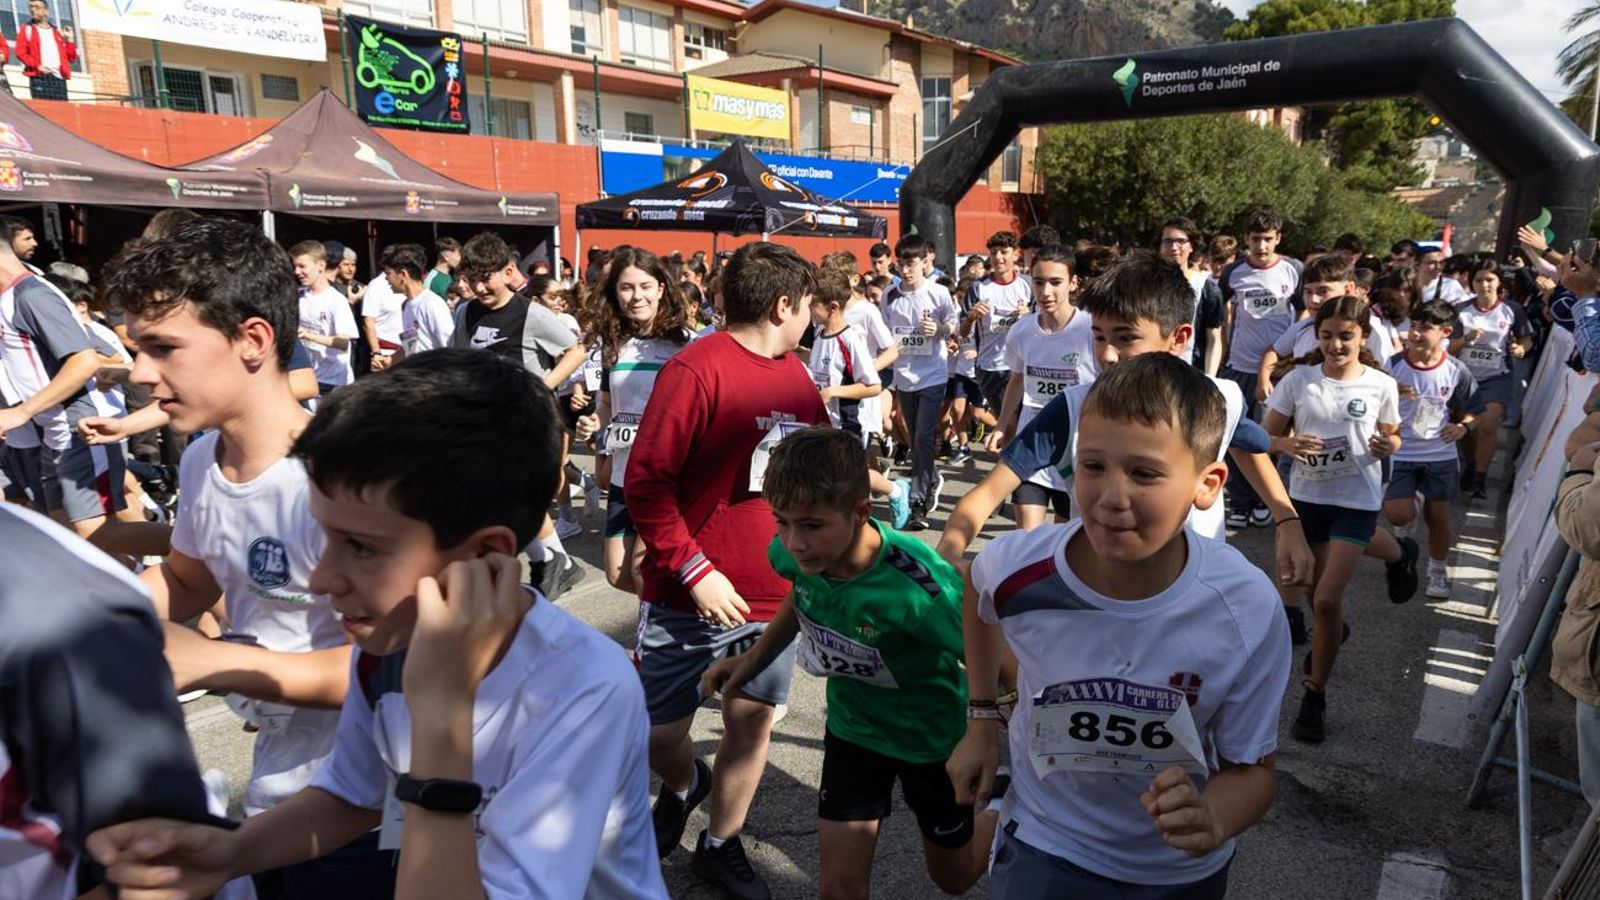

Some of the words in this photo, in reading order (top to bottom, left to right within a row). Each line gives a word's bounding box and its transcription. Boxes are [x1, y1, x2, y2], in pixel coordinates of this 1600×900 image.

[184, 0, 226, 16] Colegio
[163, 14, 217, 31] ANDRES
[222, 22, 240, 35] DE
[244, 26, 318, 44] VANDELVIRA
[1142, 69, 1199, 83] Patronato
[1202, 62, 1261, 77] Municipal
[1264, 60, 1281, 72] de
[1142, 82, 1195, 97] Deportes
[1198, 80, 1214, 91] de
[1217, 77, 1247, 89] Jaén
[713, 93, 785, 120] masymas
[797, 167, 809, 179] con
[1253, 297, 1277, 308] 949
[902, 336, 924, 346] 939
[1470, 350, 1493, 360] 862
[1061, 681, 1126, 703] XXXVI
[1126, 685, 1169, 700] CARRERA
[1134, 697, 1148, 708] LA
[1068, 711, 1174, 749] 856
